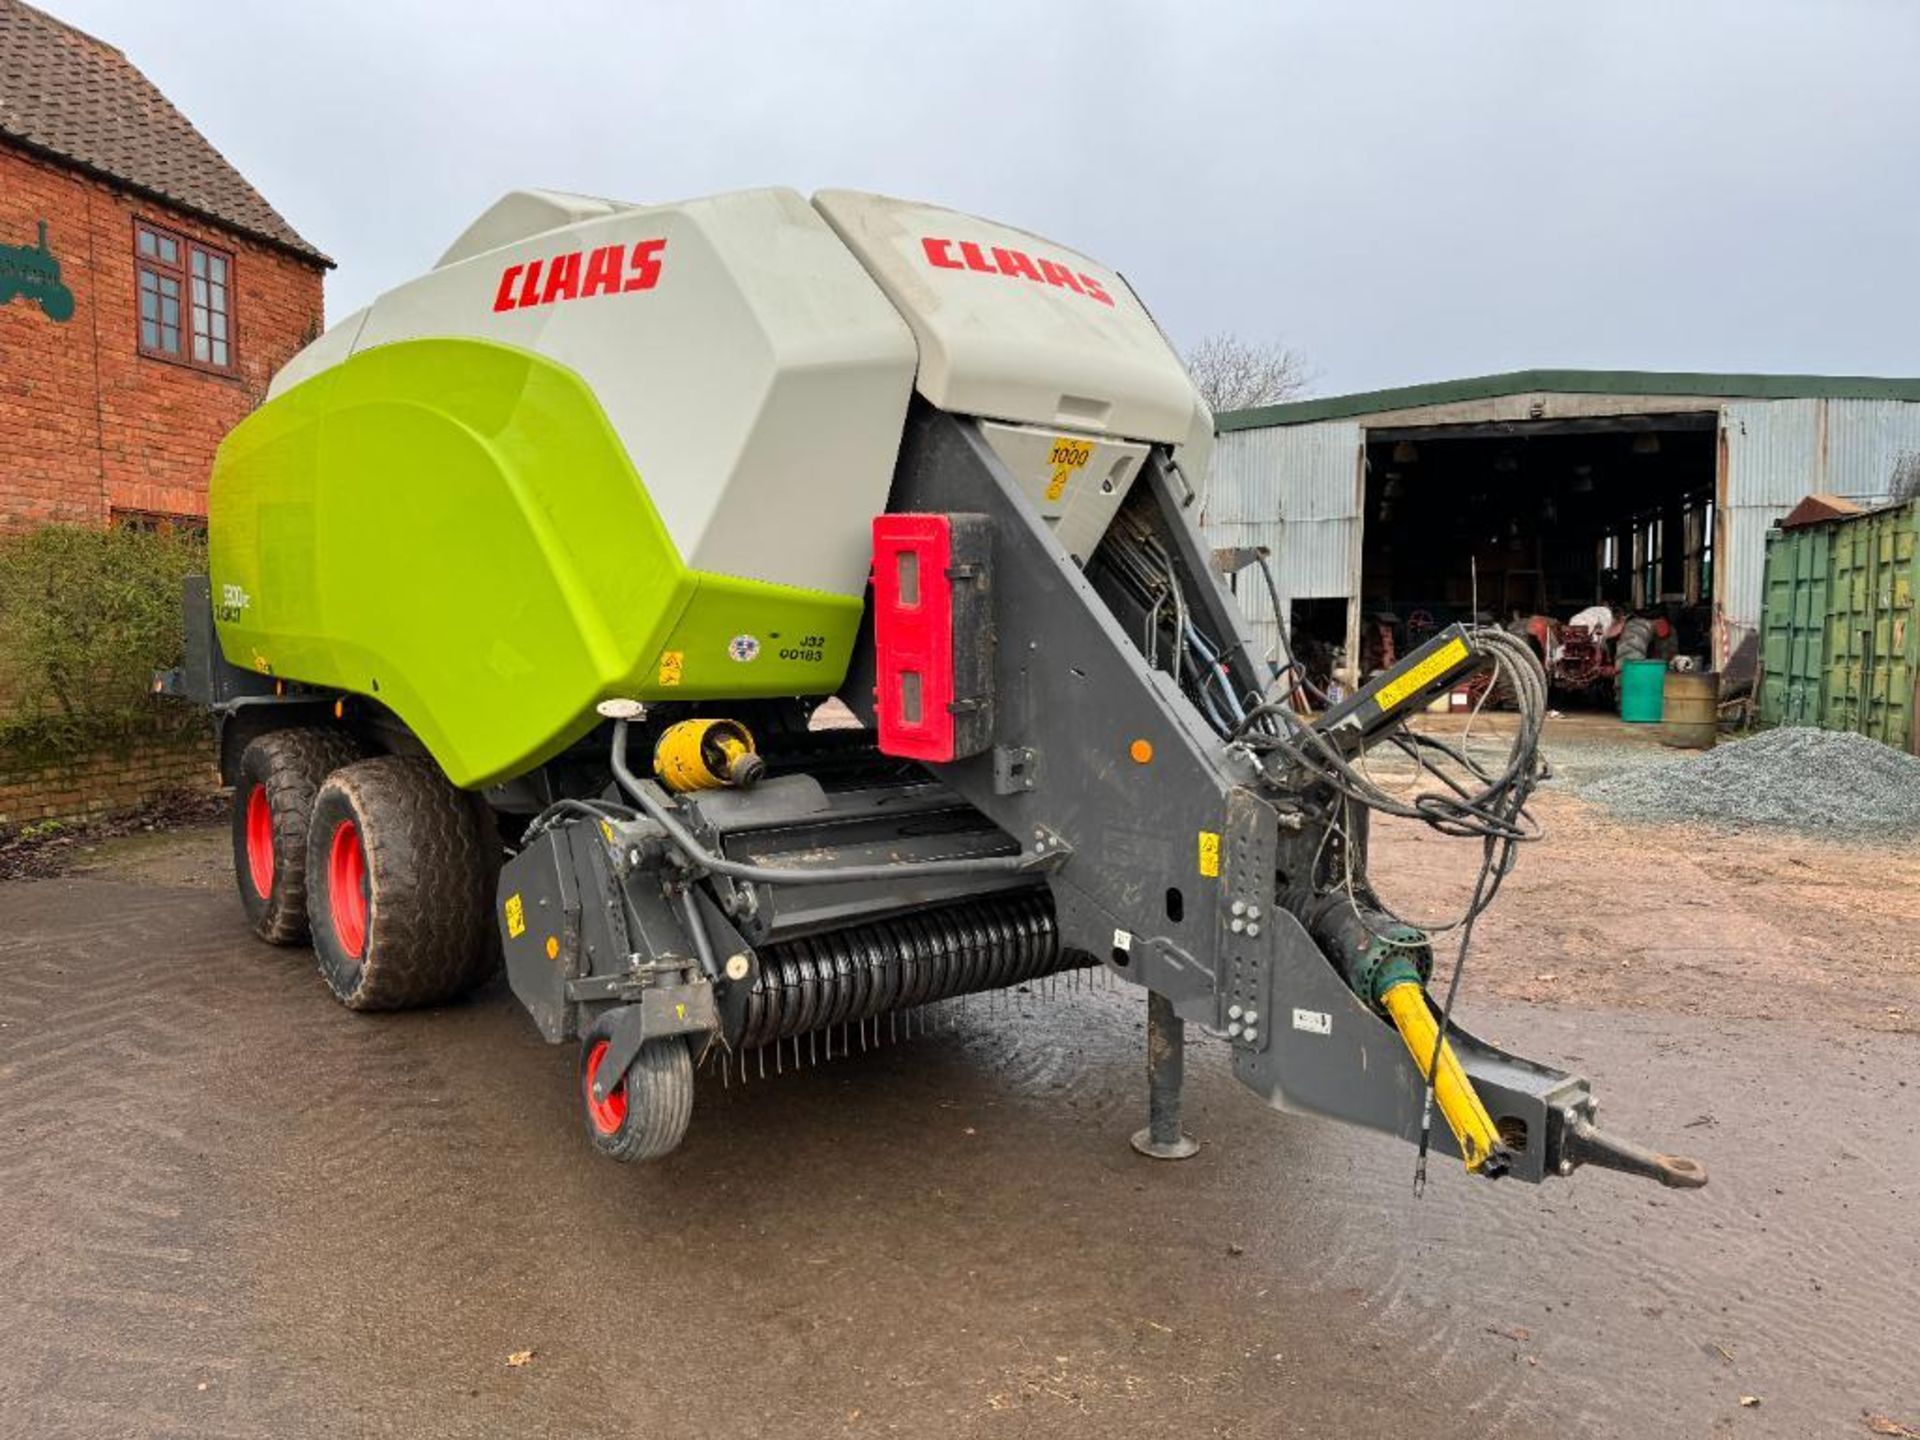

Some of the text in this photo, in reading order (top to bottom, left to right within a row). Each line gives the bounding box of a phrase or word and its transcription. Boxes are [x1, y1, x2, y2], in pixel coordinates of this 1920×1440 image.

[493, 238, 667, 312] CLAAS
[922, 237, 1115, 307] CLAAS
[1051, 445, 1090, 469] 1000
[799, 635, 825, 648] J32
